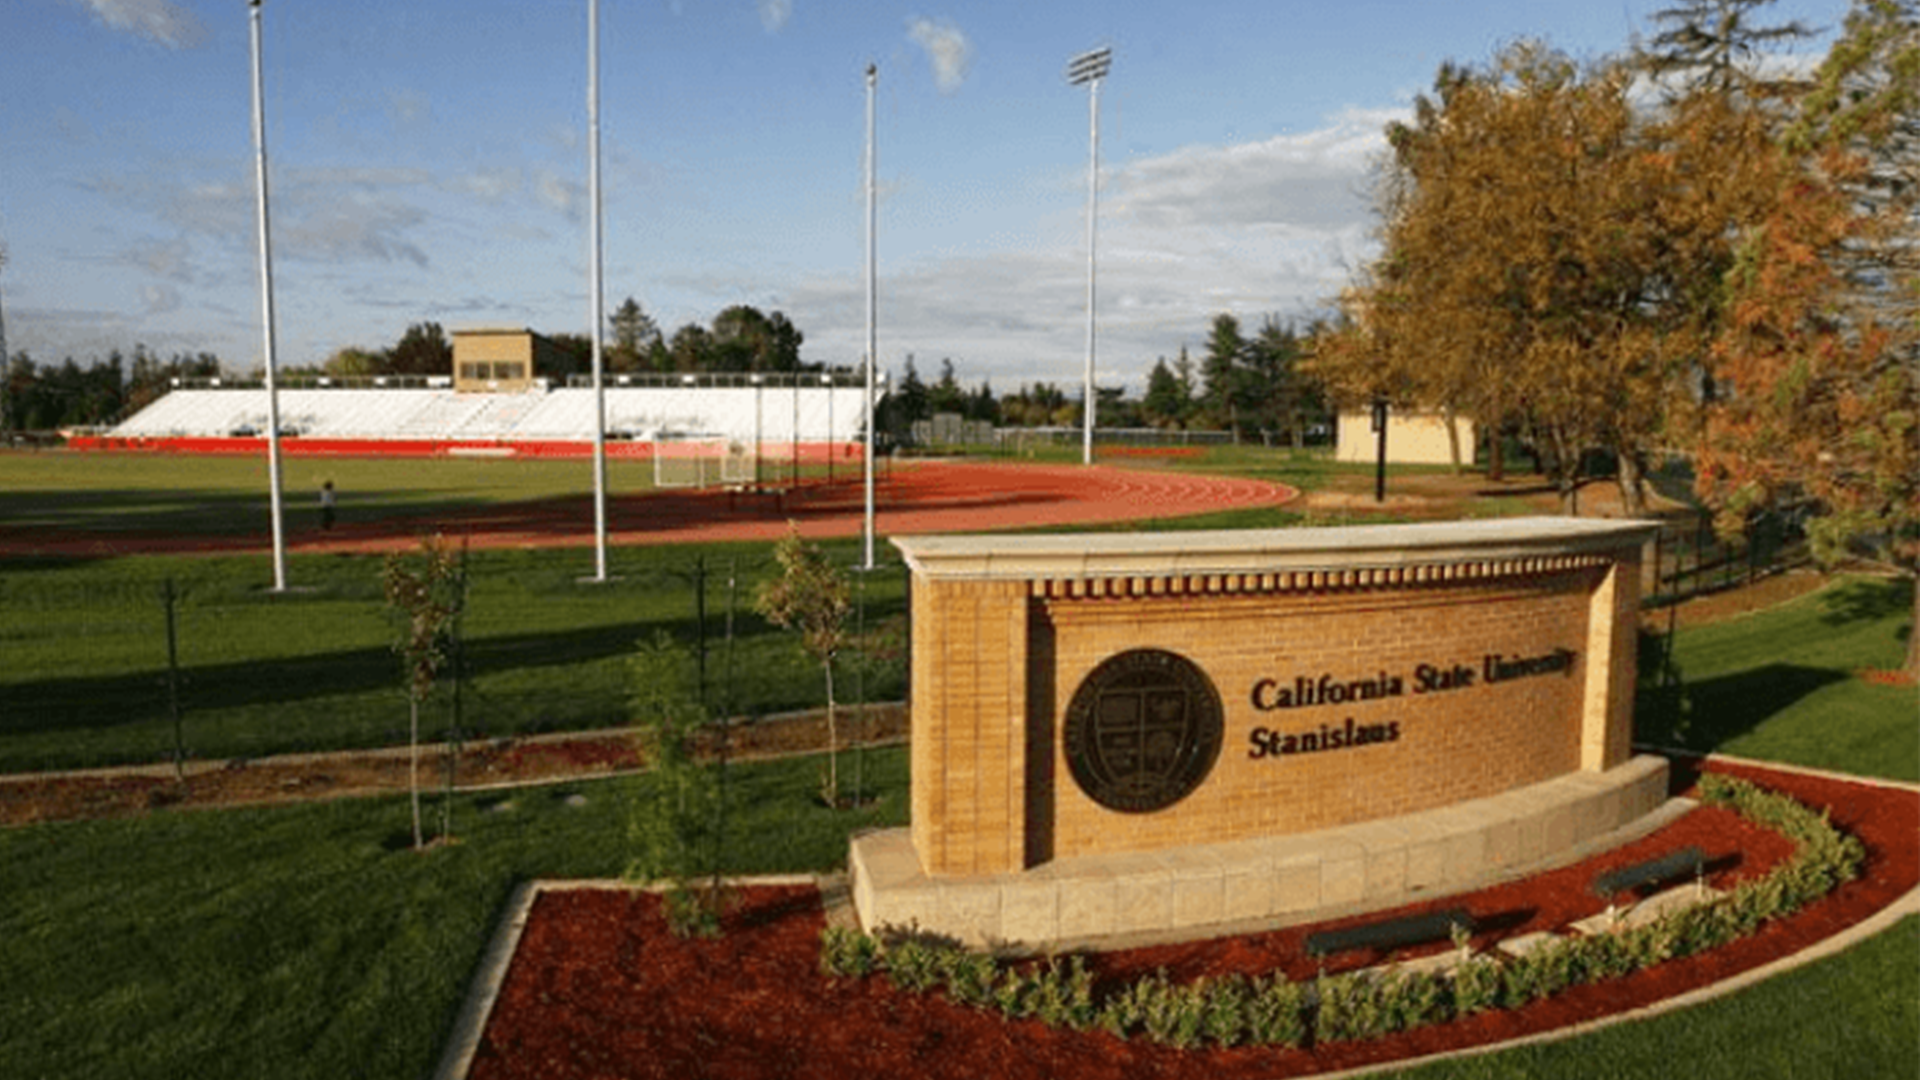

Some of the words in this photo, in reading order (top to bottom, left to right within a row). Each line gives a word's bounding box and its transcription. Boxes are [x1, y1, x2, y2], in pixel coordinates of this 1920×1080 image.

[1250, 672, 1403, 711] California
[1412, 664, 1474, 694] State
[1248, 717, 1400, 759] Stanislaus
